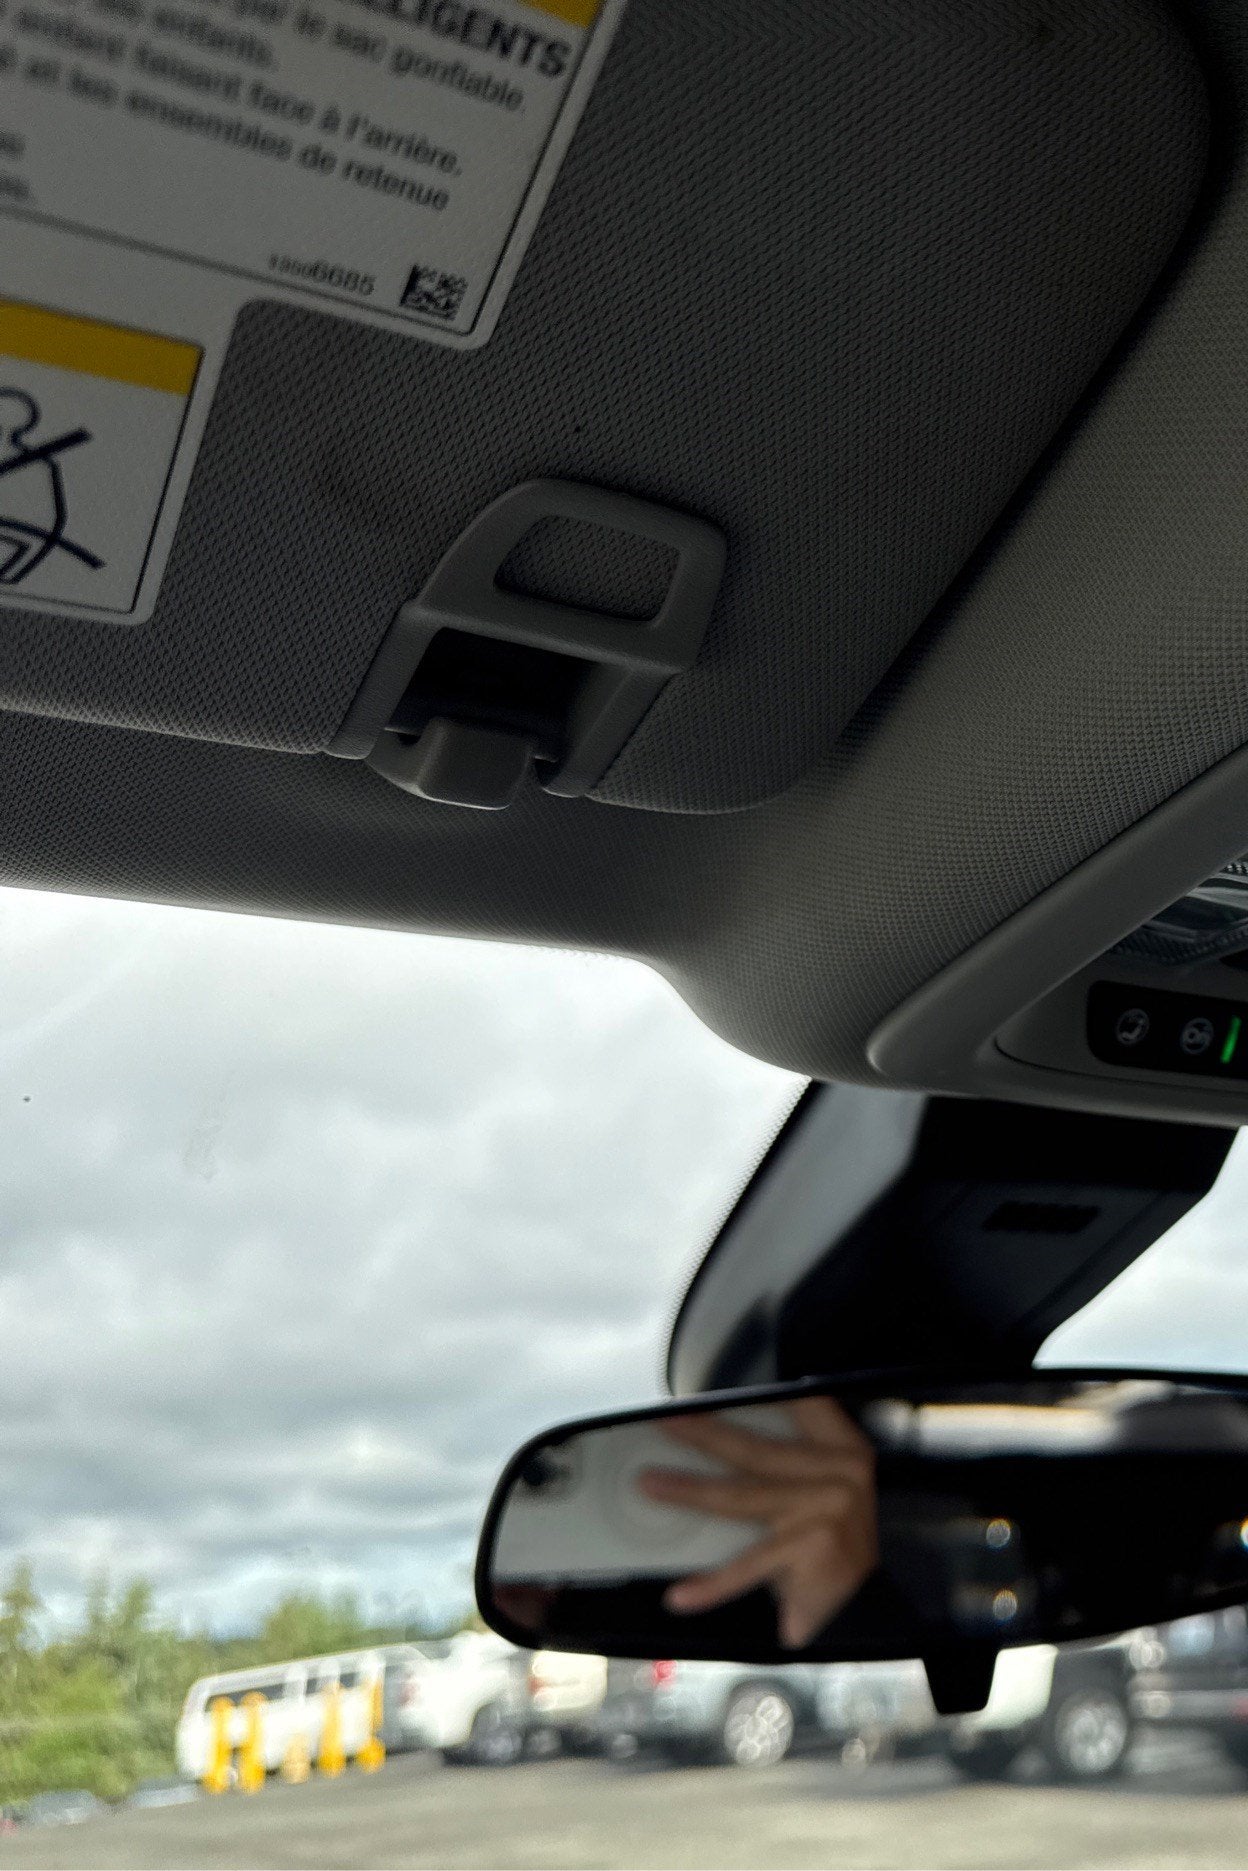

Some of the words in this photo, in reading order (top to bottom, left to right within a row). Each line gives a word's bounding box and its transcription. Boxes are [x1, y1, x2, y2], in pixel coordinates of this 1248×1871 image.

[358, 0, 573, 78] LIGENTS
[249, 81, 315, 125] face
[319, 104, 341, 135] à
[126, 92, 293, 161] ensembles
[299, 141, 338, 176] de
[341, 157, 450, 212] retenue
